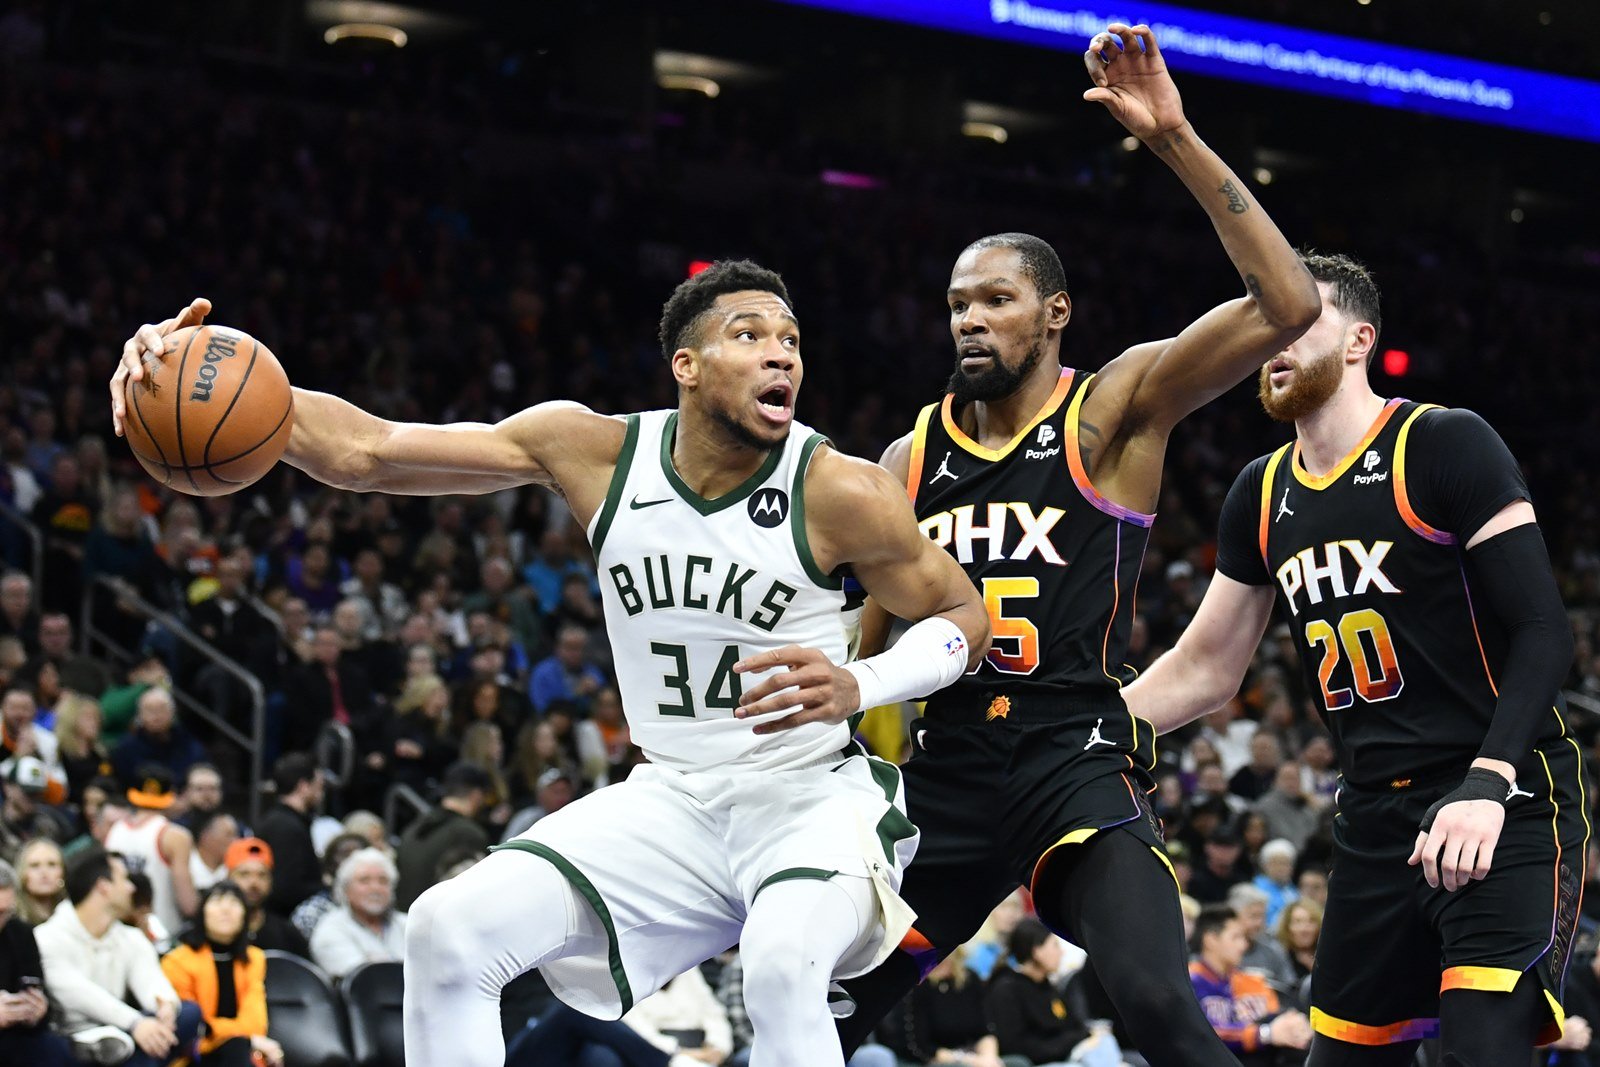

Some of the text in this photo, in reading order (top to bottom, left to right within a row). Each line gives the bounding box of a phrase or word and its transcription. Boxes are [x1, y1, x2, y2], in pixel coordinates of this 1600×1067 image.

[1353, 471, 1388, 485] PayPal
[608, 553, 798, 632] BUCKS
[1276, 539, 1405, 616] PHX
[964, 576, 1040, 676] 5
[1304, 608, 1405, 712] 20
[649, 641, 743, 719] 34
